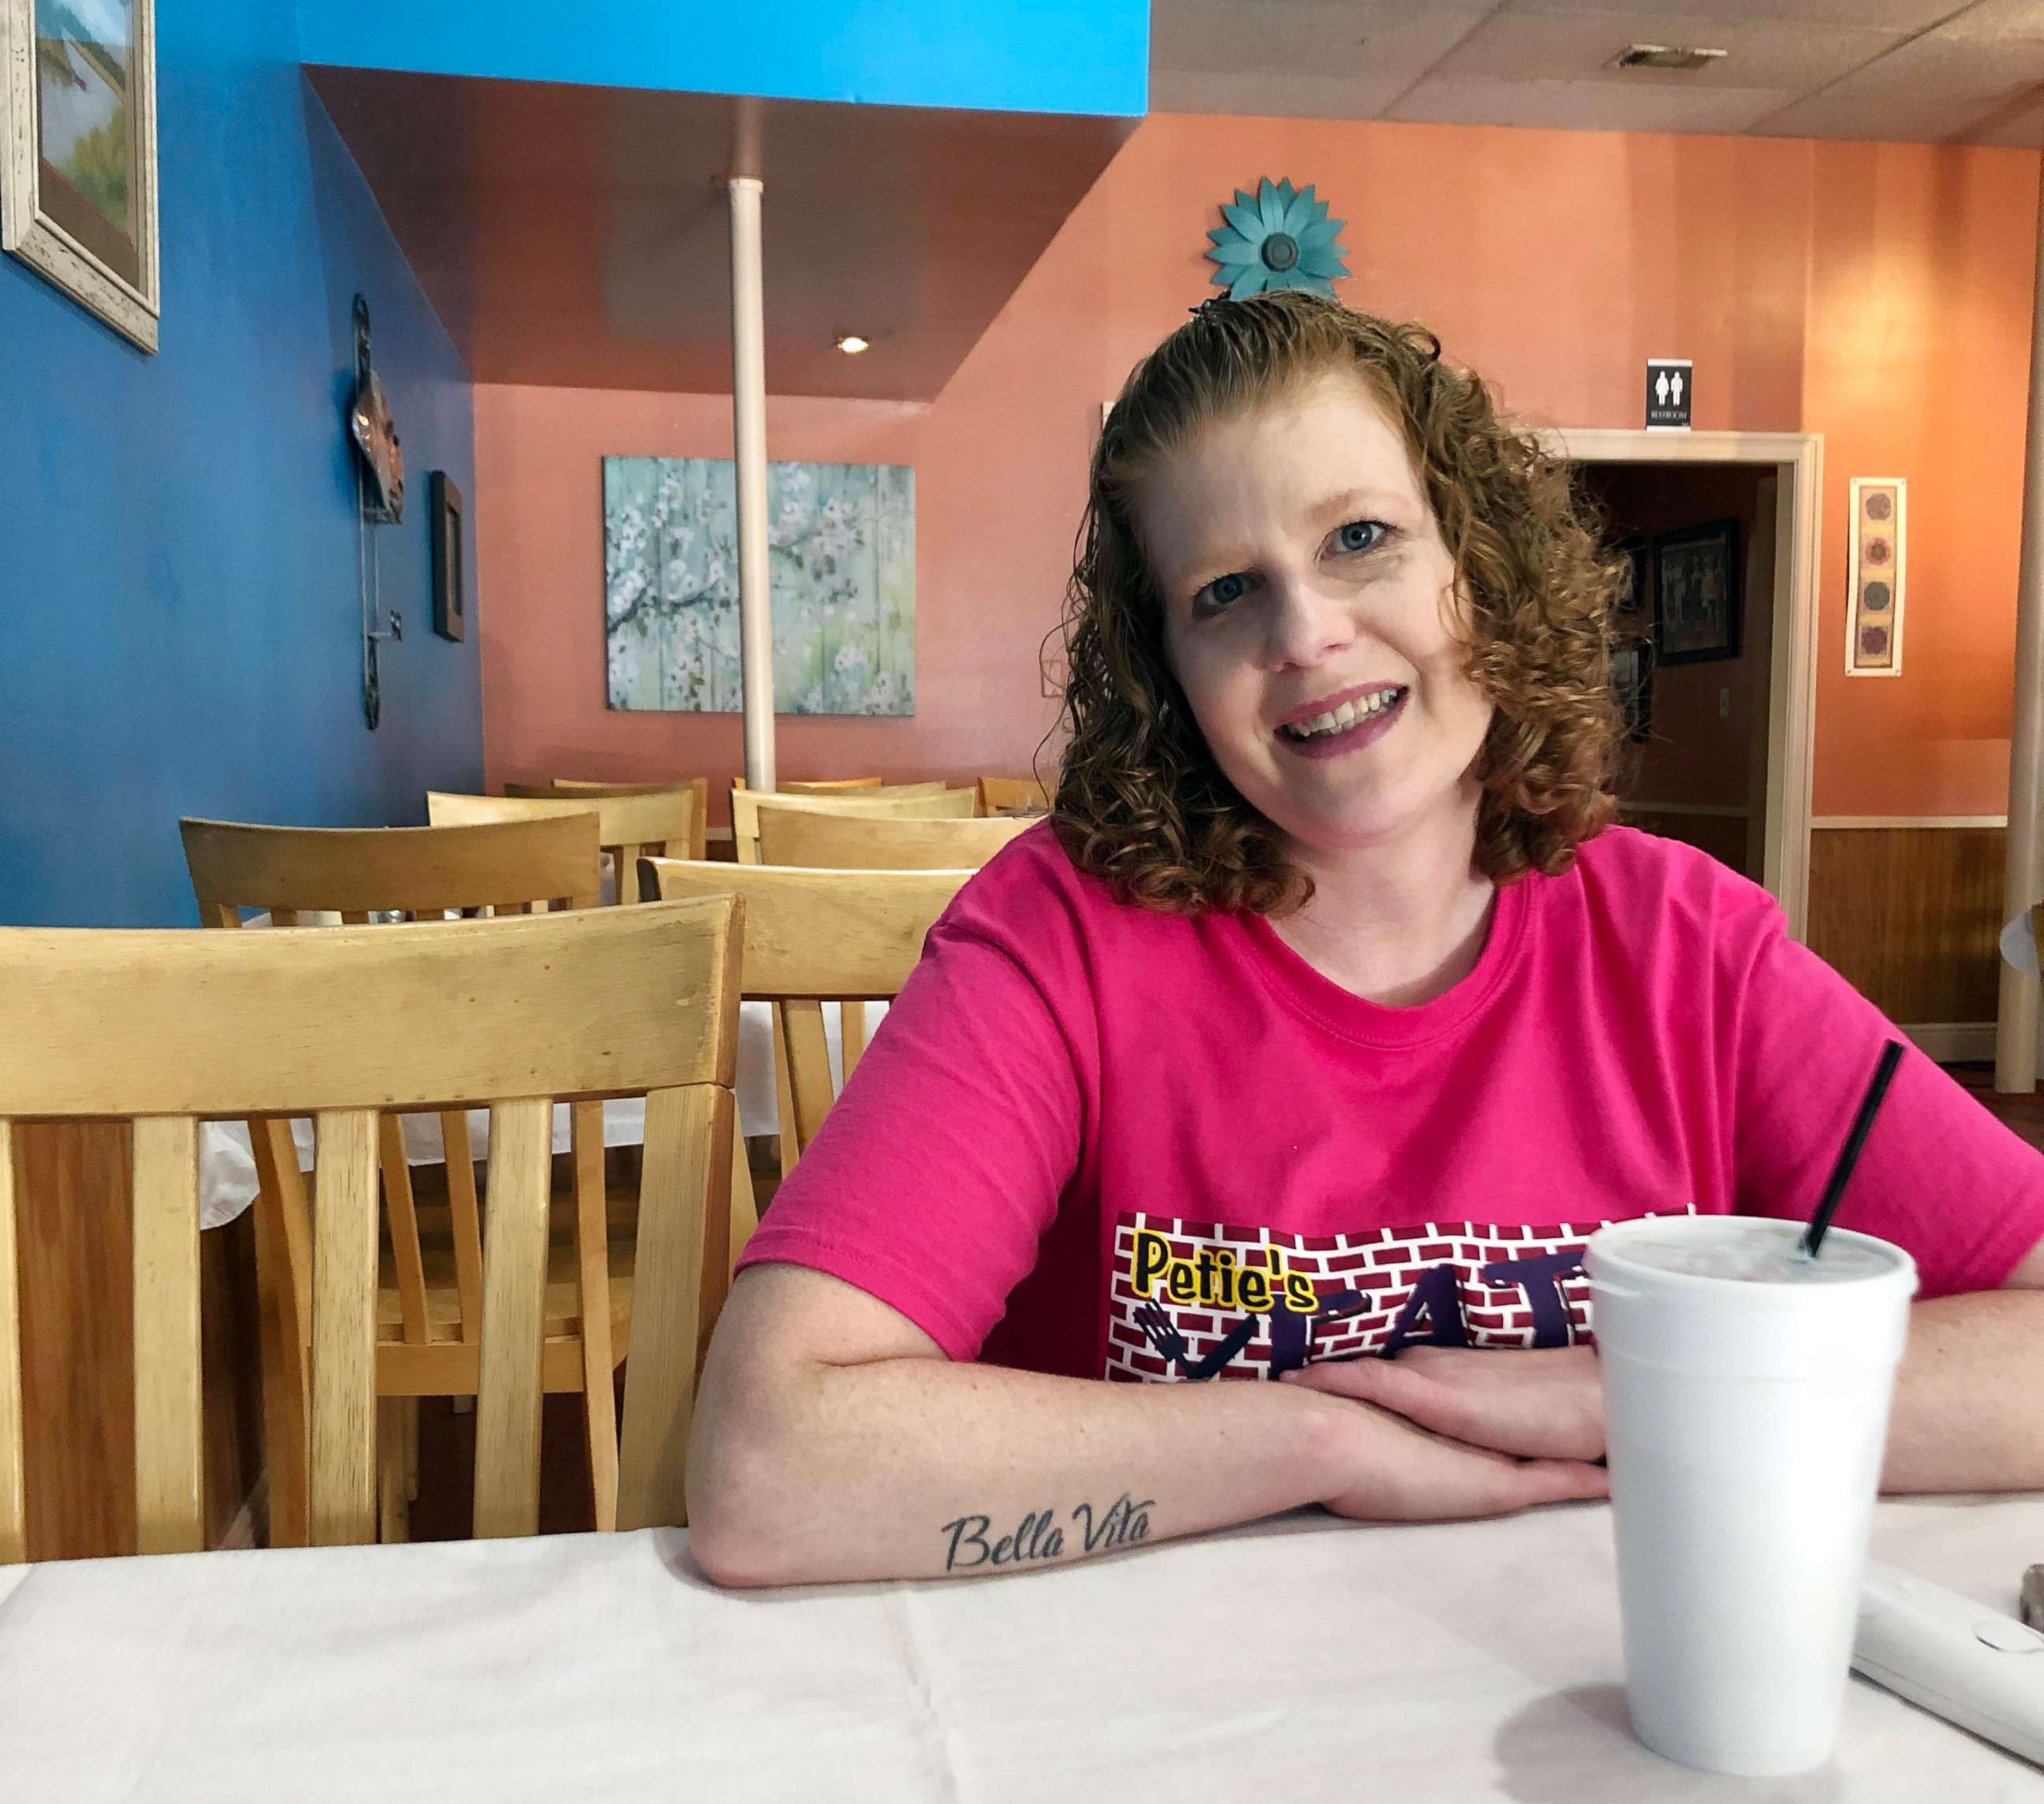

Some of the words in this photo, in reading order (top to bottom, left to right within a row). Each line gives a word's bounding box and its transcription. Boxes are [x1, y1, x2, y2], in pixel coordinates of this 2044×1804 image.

[1131, 1229, 1318, 1311] Petie's
[942, 1509, 1064, 1571] Bella
[1072, 1493, 1154, 1552] Vita
